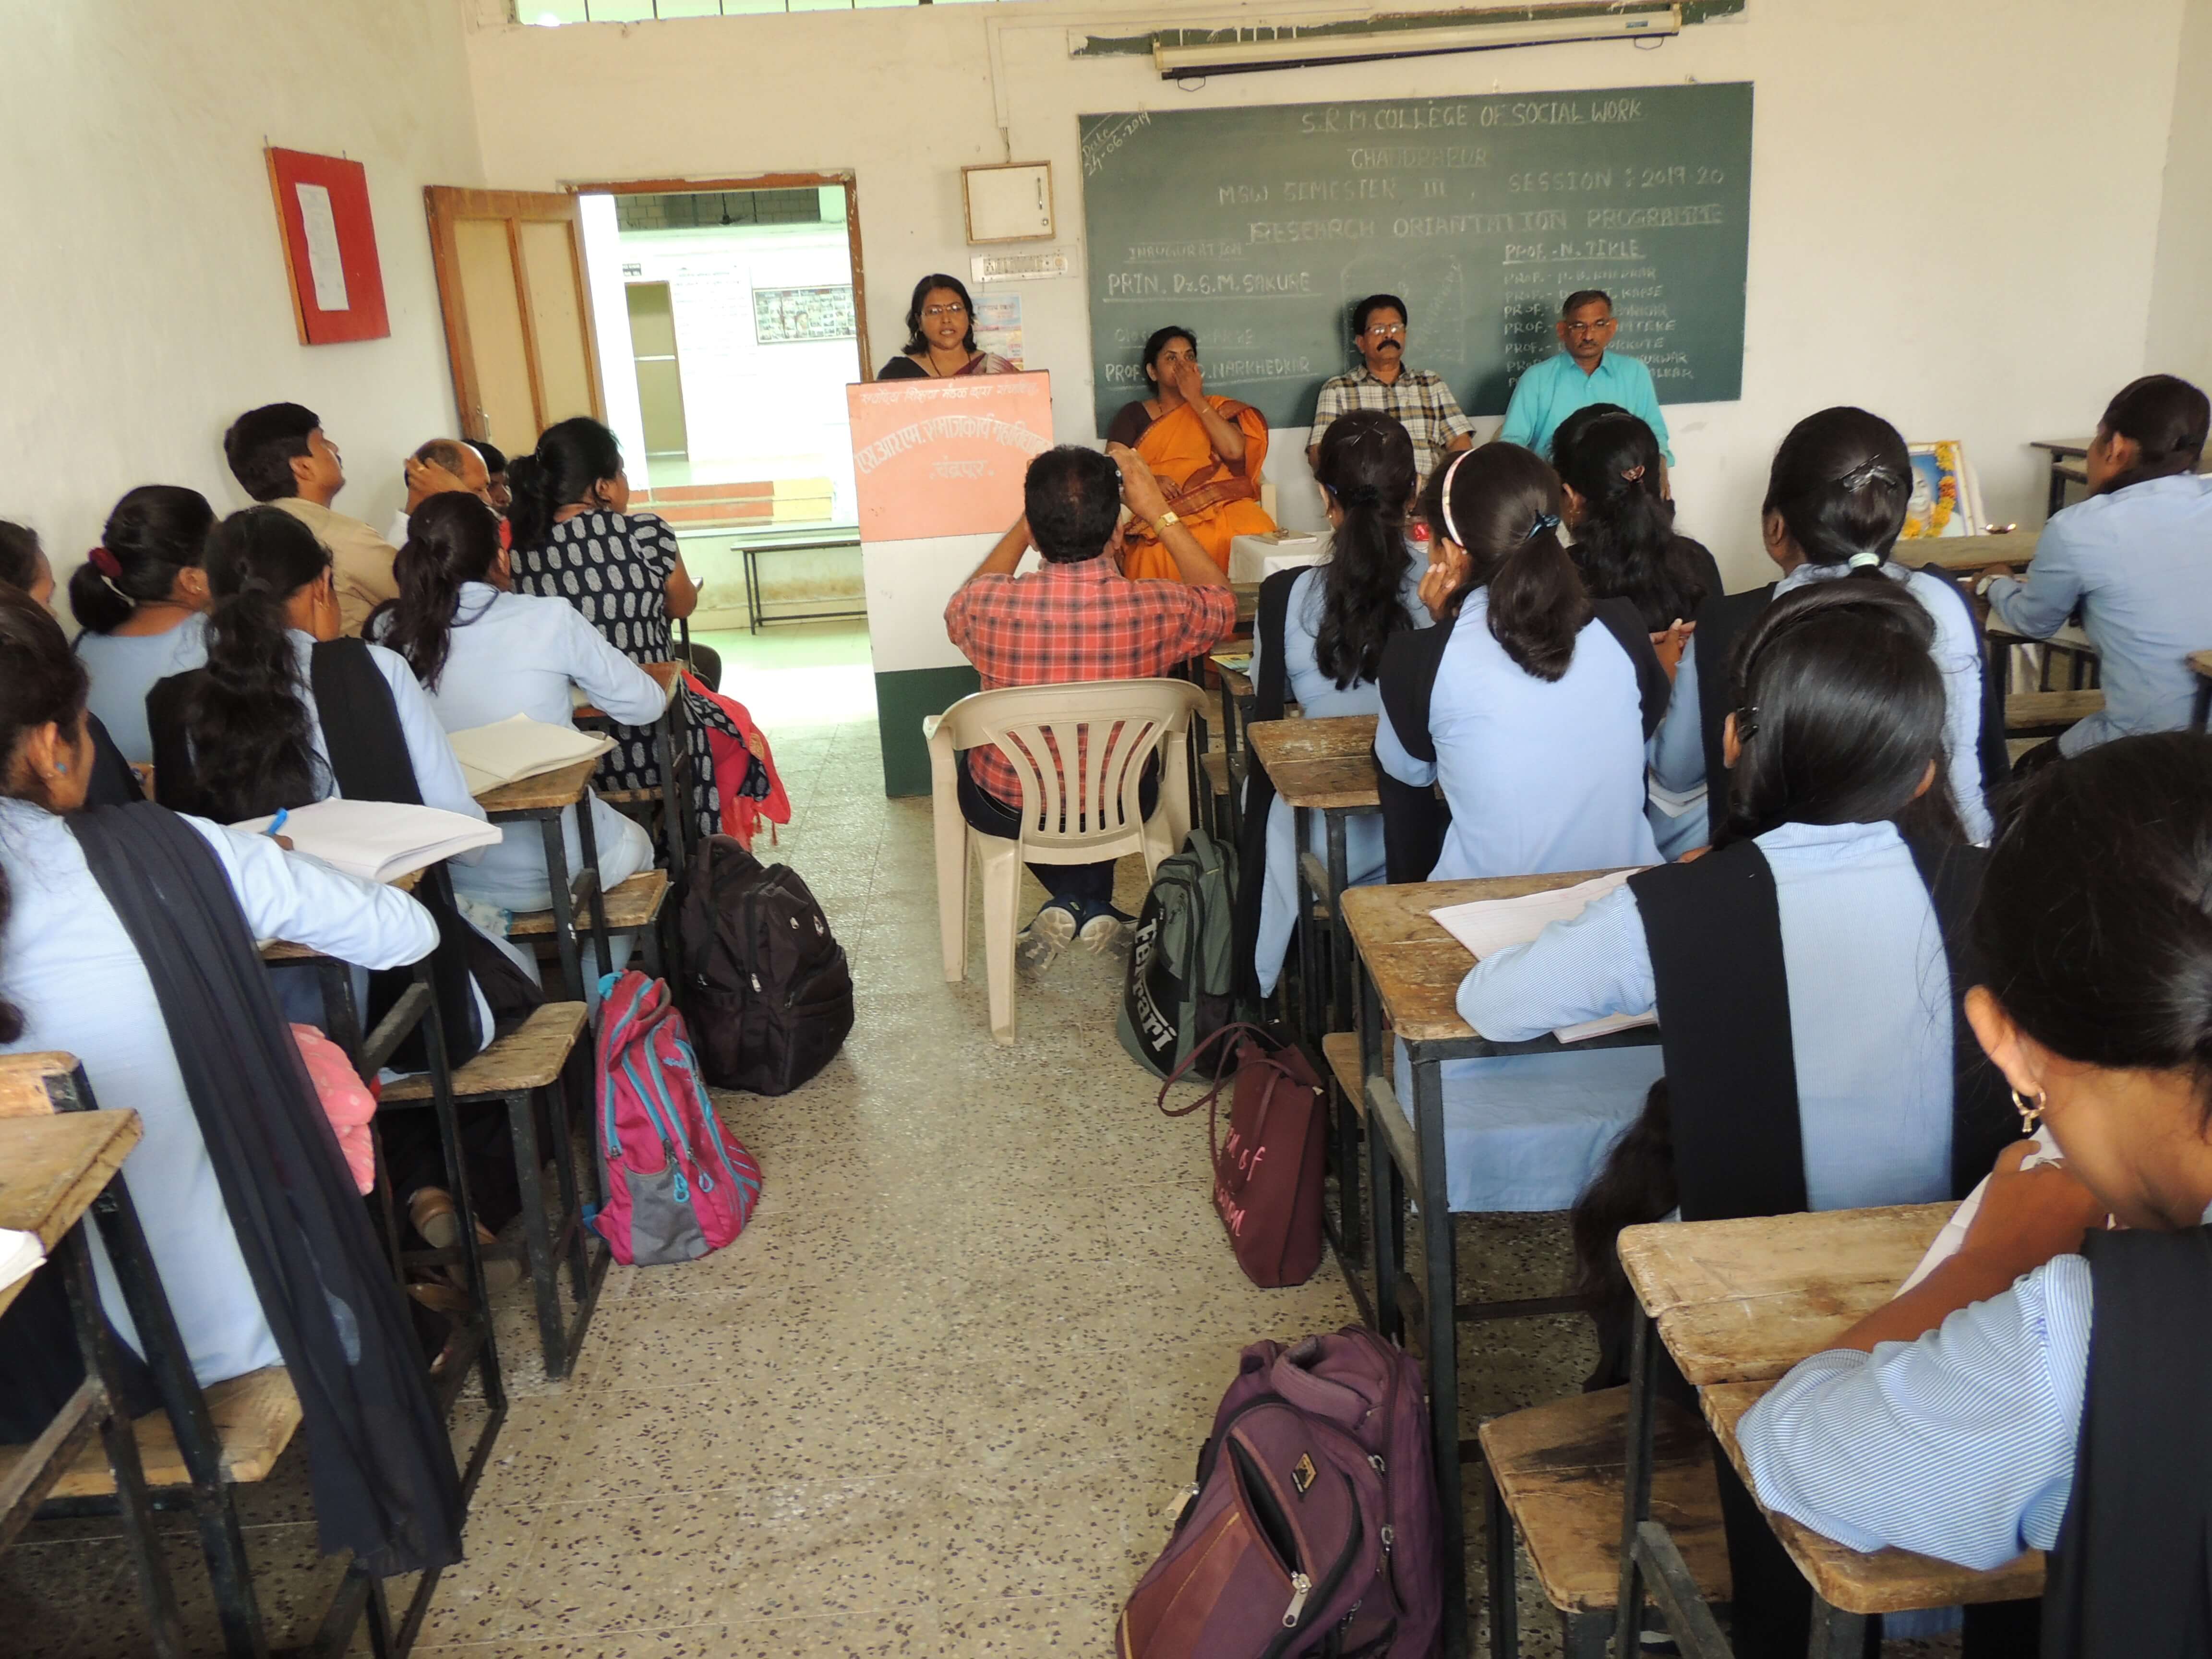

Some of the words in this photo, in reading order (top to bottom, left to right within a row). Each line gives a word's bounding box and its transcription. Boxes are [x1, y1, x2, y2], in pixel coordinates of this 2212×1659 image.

[1481, 104, 1505, 127] OF
[1512, 102, 1583, 124] SOCIAL
[1591, 98, 1641, 122] WORK
[1509, 169, 1613, 192] SESSION
[1133, 918, 1177, 1052] Ferrari
